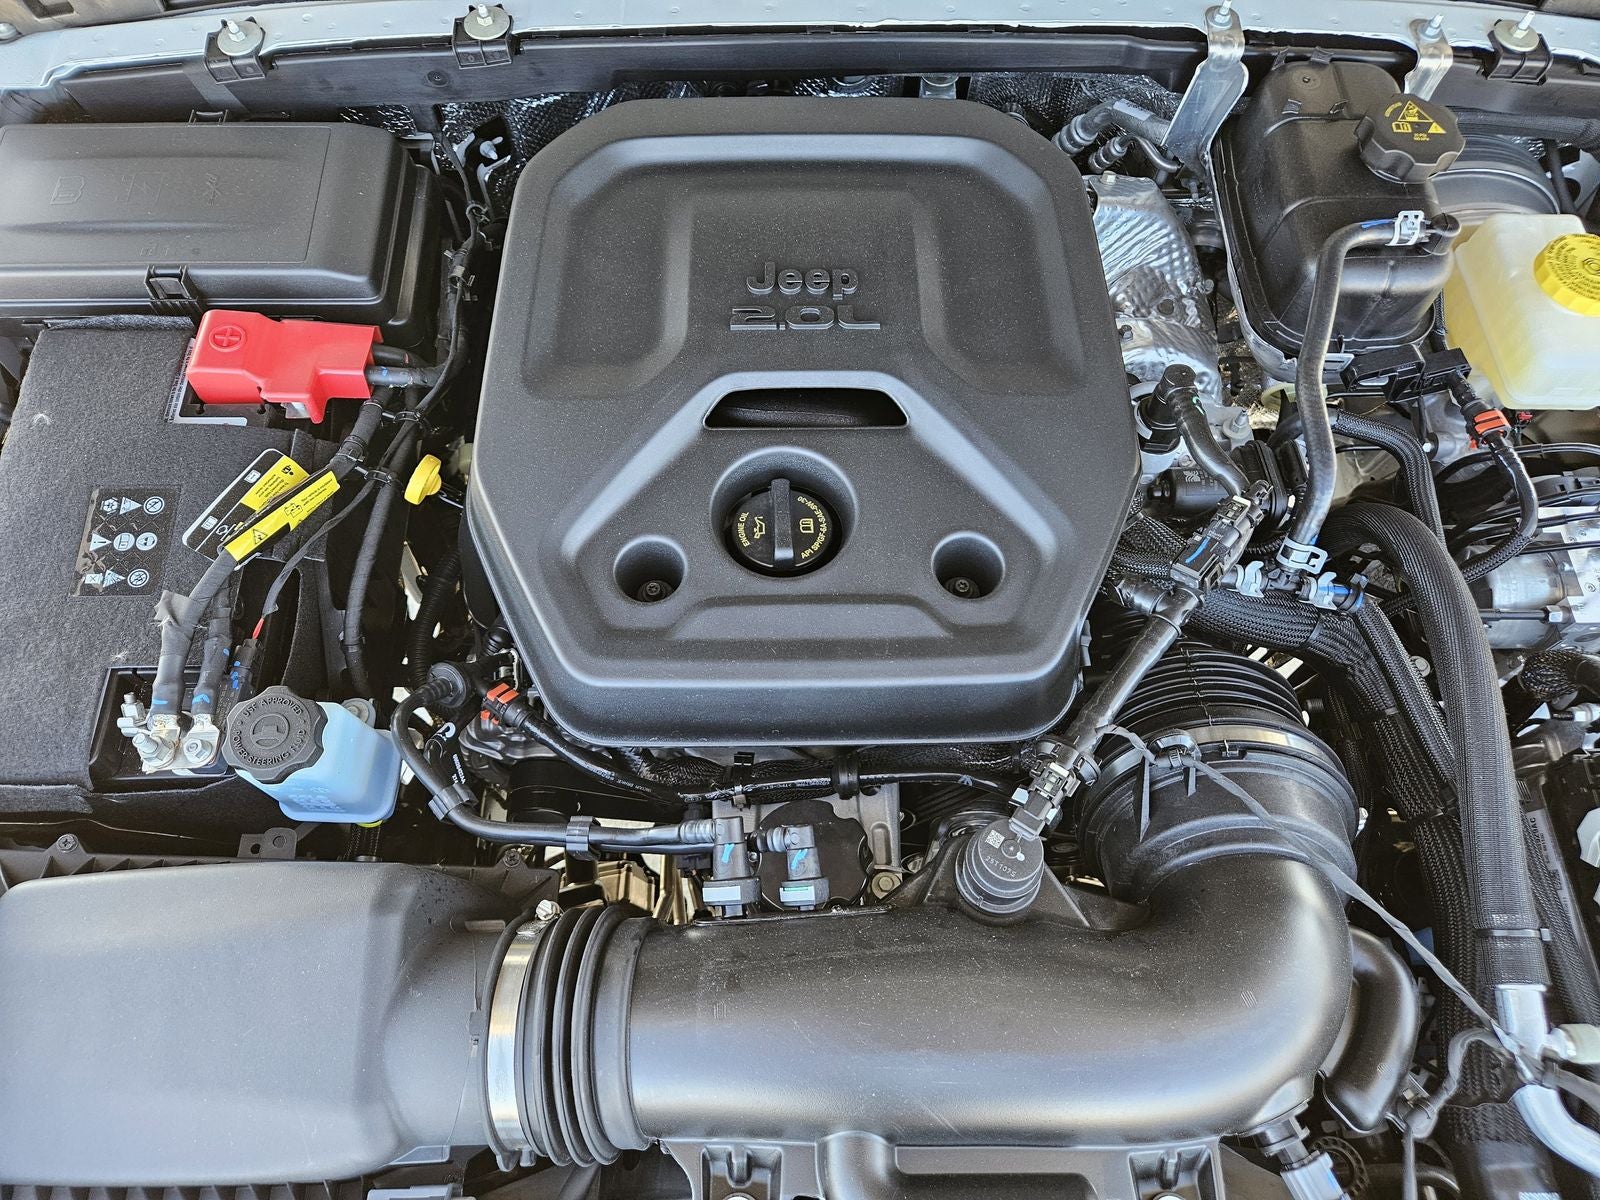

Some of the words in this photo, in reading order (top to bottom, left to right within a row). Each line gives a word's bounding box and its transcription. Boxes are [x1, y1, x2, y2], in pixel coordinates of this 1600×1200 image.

[746, 261, 859, 300] Jeep
[730, 305, 881, 331] 2.0L
[739, 511, 750, 522] OIL
[737, 522, 751, 548] ENGINE
[801, 548, 814, 559] API
[243, 703, 257, 718] USE
[261, 697, 304, 716] APPROVED
[232, 728, 247, 758] POWER
[248, 751, 291, 767] STEERING
[290, 729, 307, 752] FLUID
